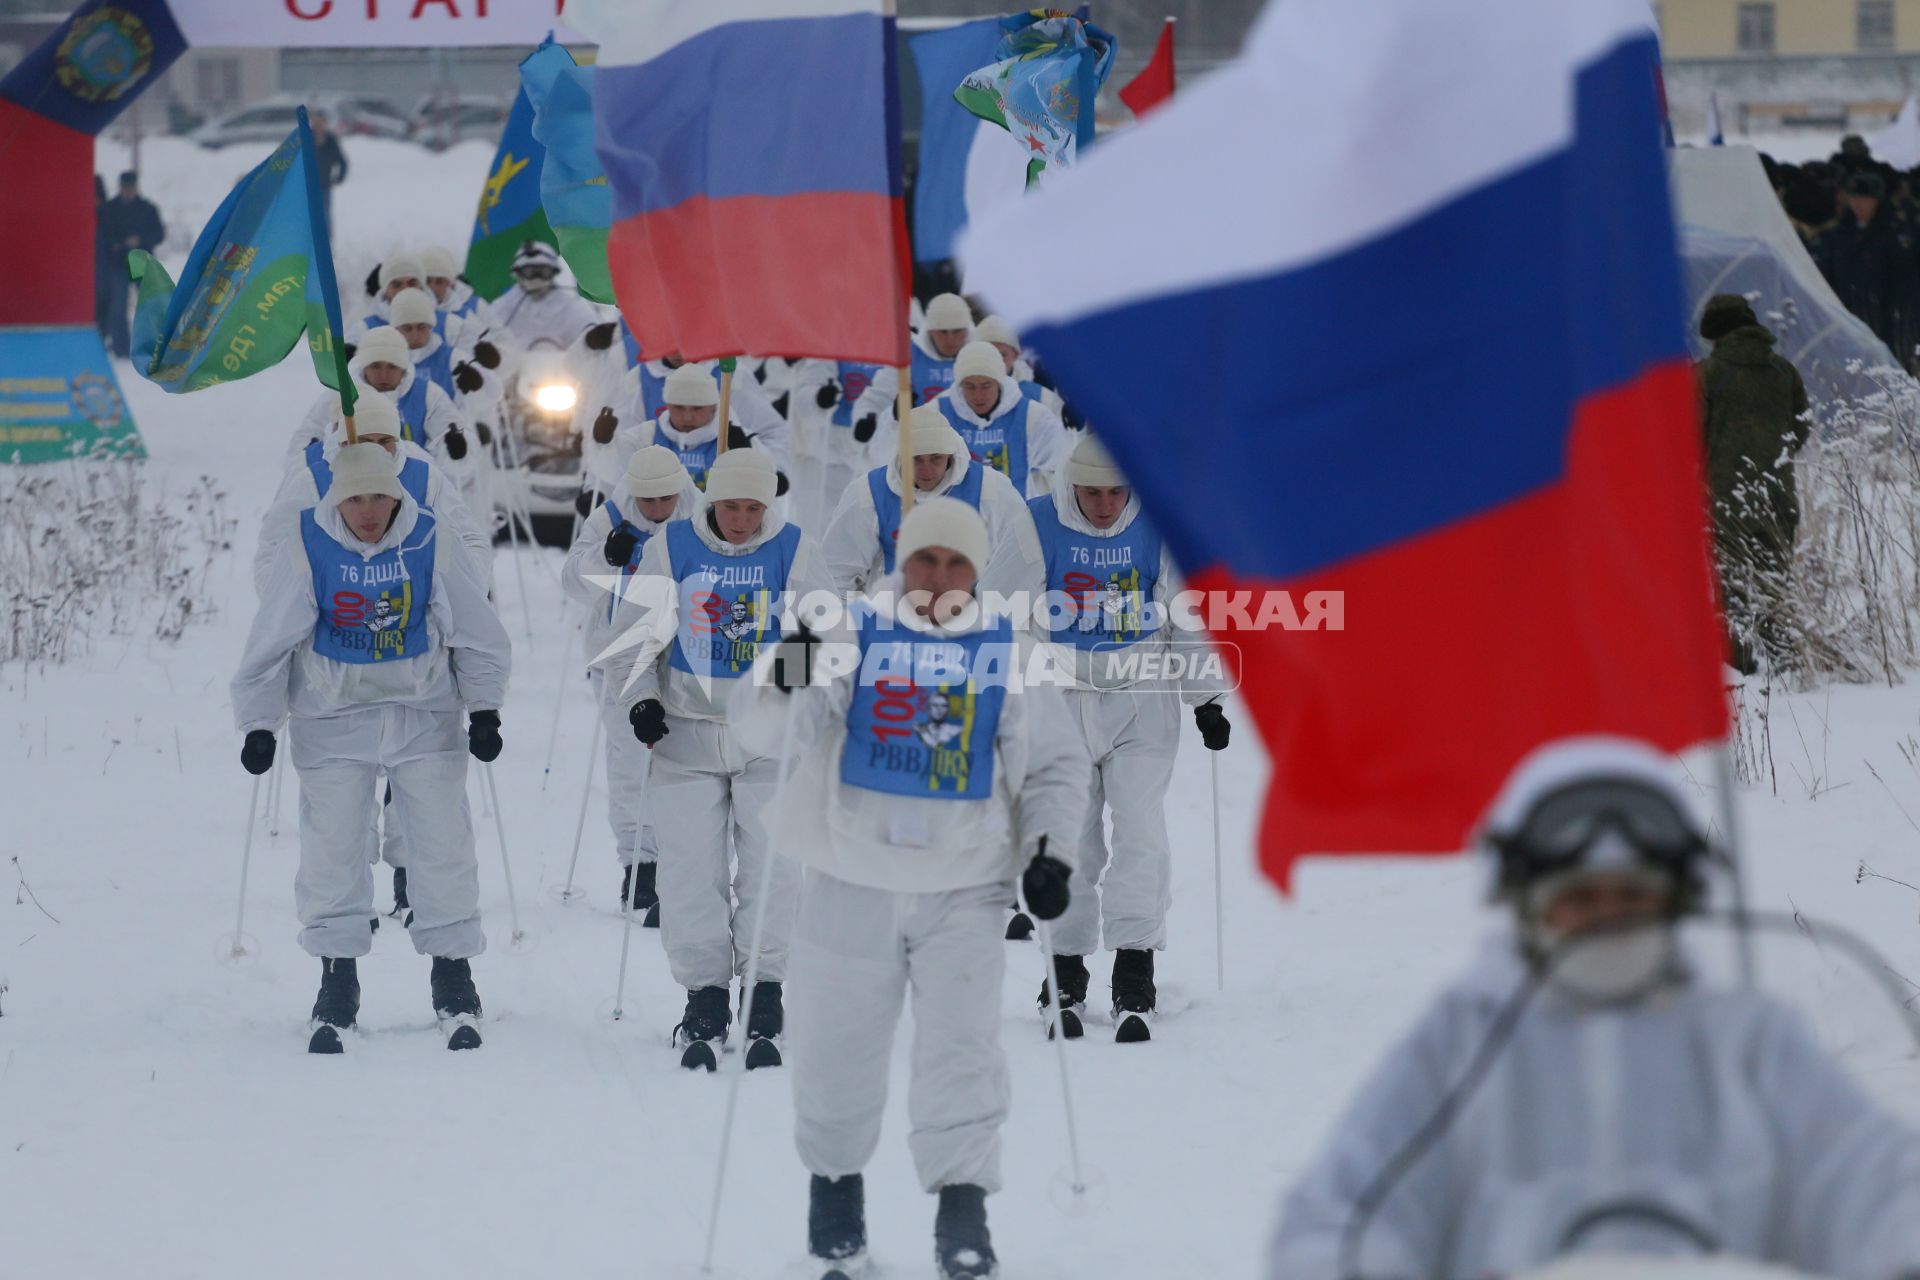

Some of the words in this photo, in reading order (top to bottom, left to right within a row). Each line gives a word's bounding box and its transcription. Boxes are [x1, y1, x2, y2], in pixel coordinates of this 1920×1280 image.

[340, 564, 359, 583] 76
[363, 562, 406, 586] ДШД
[700, 564, 718, 582] 76
[721, 566, 764, 588] ДШД
[1070, 546, 1089, 564] 76
[1094, 546, 1132, 569] ДШД
[332, 591, 365, 628] 100
[1063, 571, 1097, 616] 100
[688, 591, 722, 637] 100
[871, 674, 918, 744] 100
